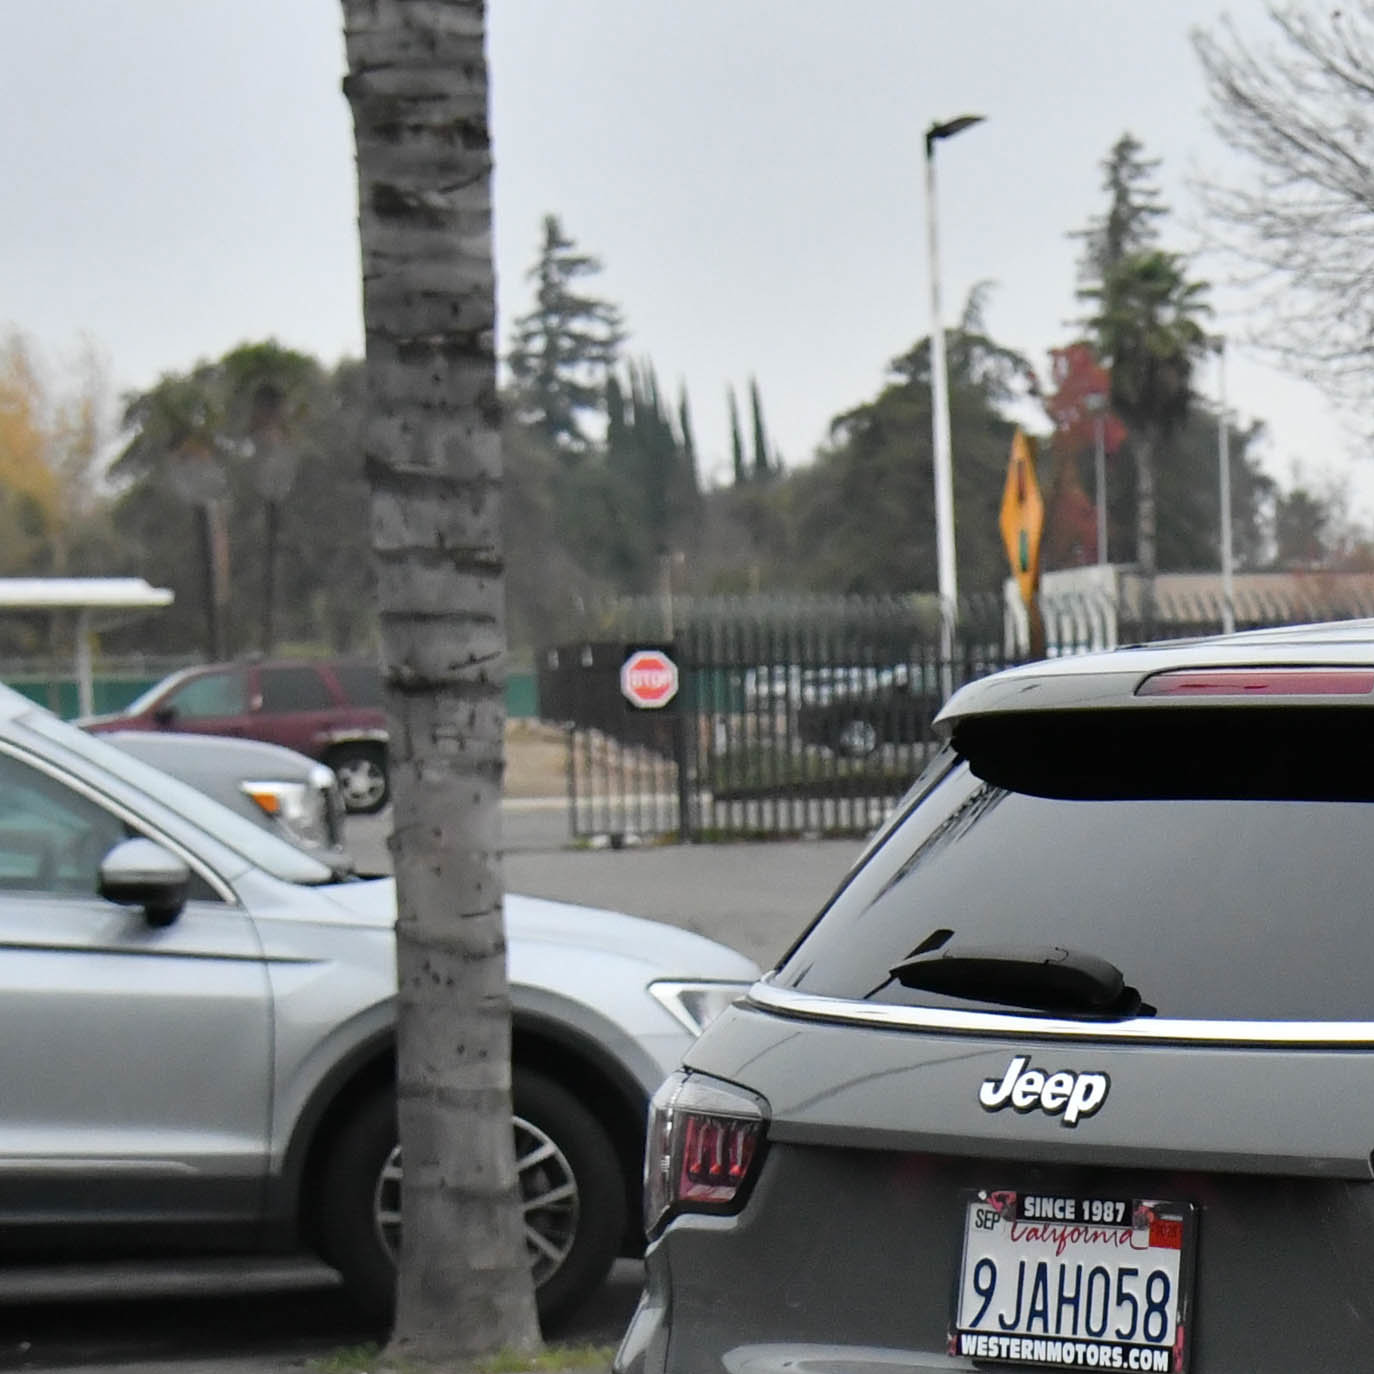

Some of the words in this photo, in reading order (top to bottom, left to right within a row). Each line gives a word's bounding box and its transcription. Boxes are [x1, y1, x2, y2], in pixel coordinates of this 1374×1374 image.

[630, 669, 672, 689] STOP
[979, 1055, 1109, 1126] Jeep
[975, 1208, 1001, 1231] SEP
[1024, 1196, 1075, 1220] SINCE
[1082, 1200, 1125, 1224] 1987
[1010, 1221, 1149, 1256] California
[969, 1257, 1172, 1343] 9JAH058
[961, 1333, 1169, 1372] WESTERNMOTORS.COM
